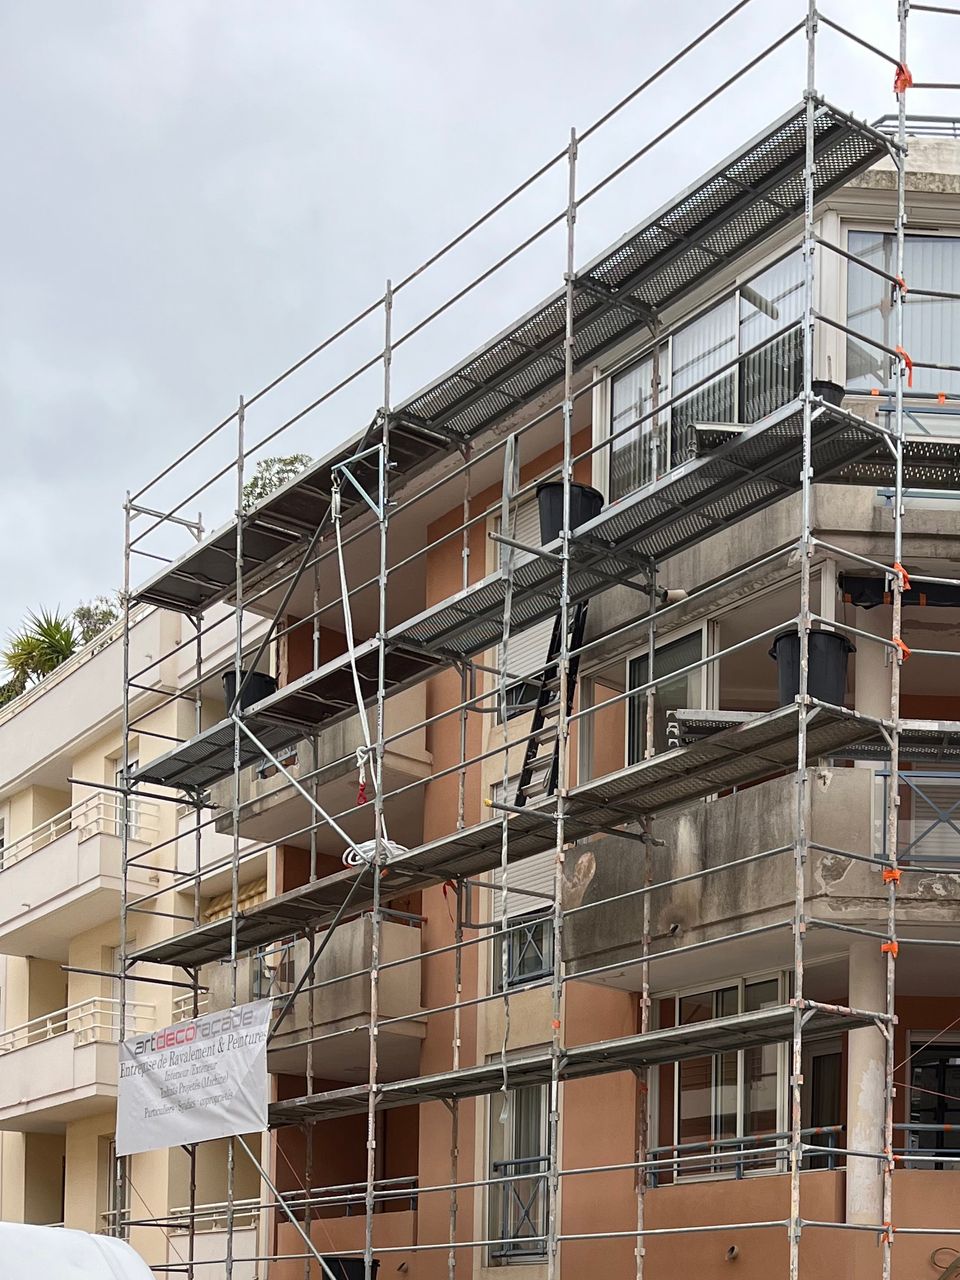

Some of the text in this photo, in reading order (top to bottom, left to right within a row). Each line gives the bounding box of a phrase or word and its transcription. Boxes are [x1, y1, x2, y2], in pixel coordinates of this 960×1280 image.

[157, 1053, 168, 1070] de
[169, 1043, 216, 1067] Ravalement
[217, 1036, 224, 1054] &
